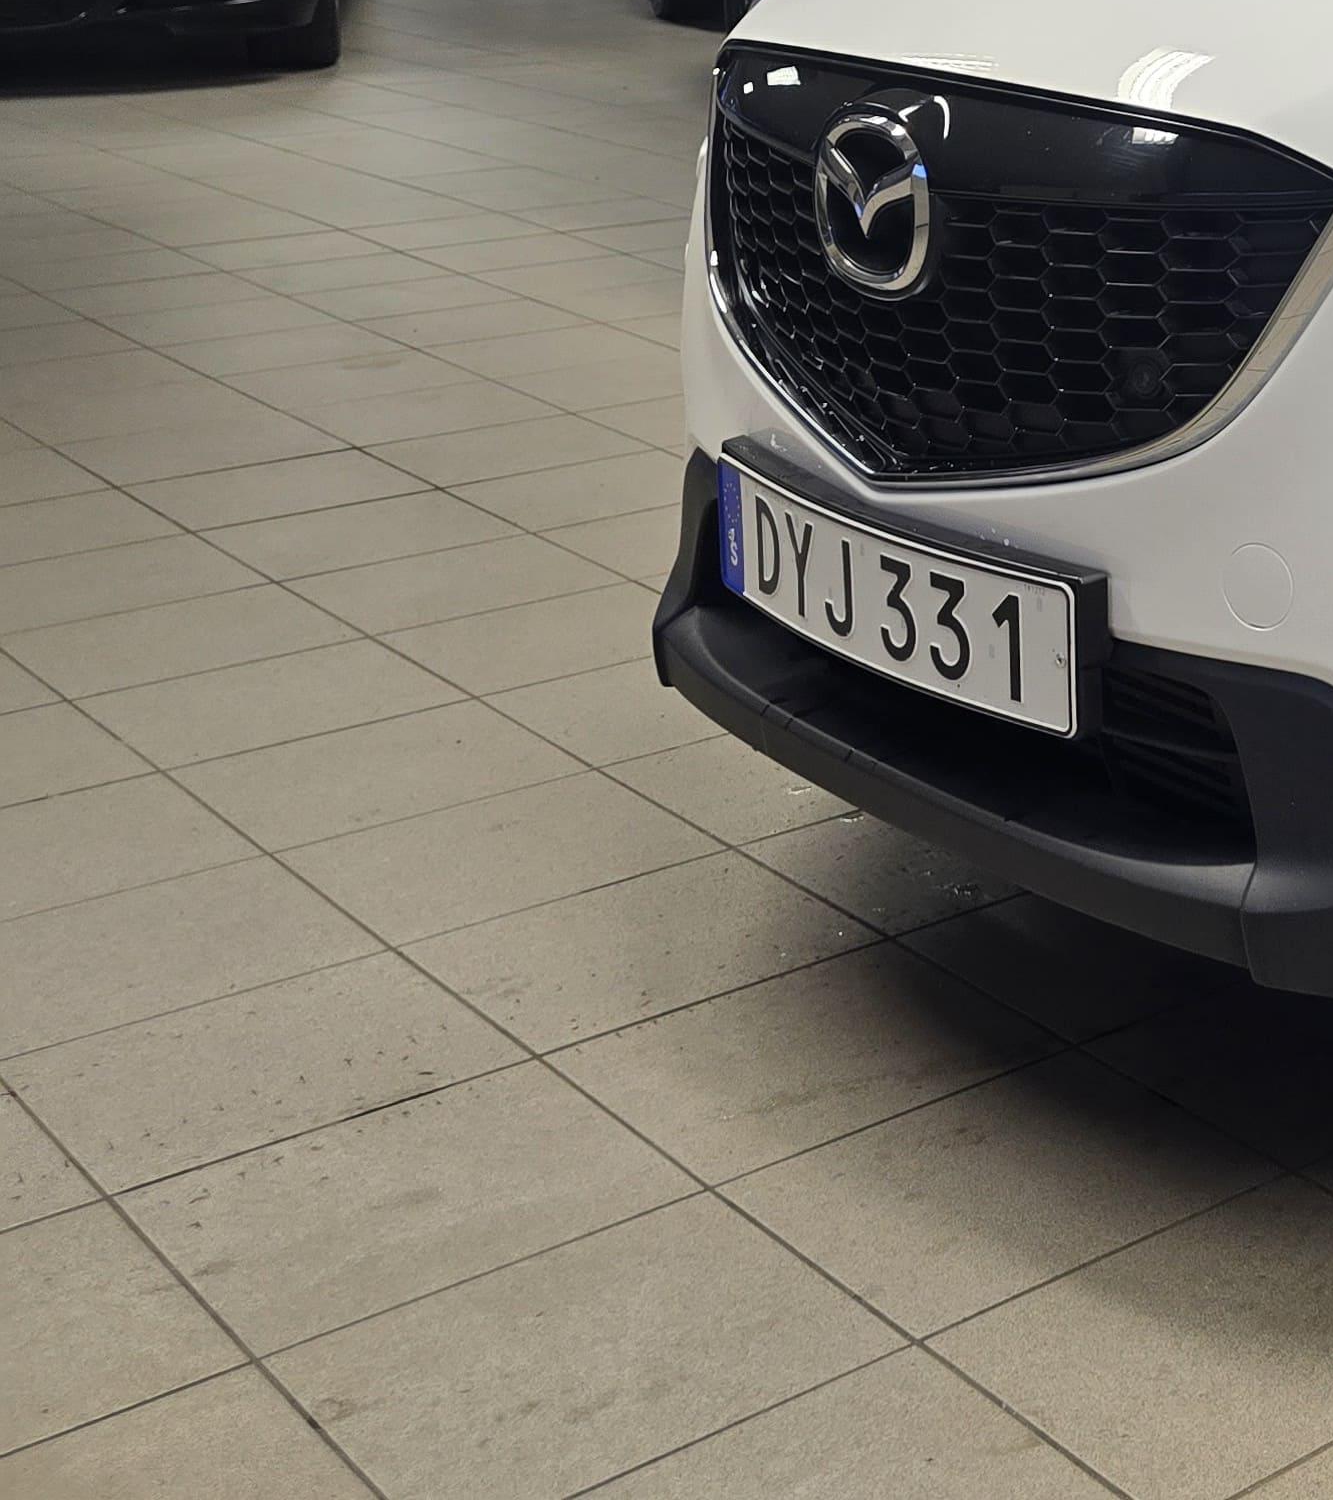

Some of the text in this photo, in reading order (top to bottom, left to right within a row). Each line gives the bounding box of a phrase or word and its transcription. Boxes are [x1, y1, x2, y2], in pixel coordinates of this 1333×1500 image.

[728, 540, 740, 566] S
[755, 493, 1023, 703] DYJ 331
